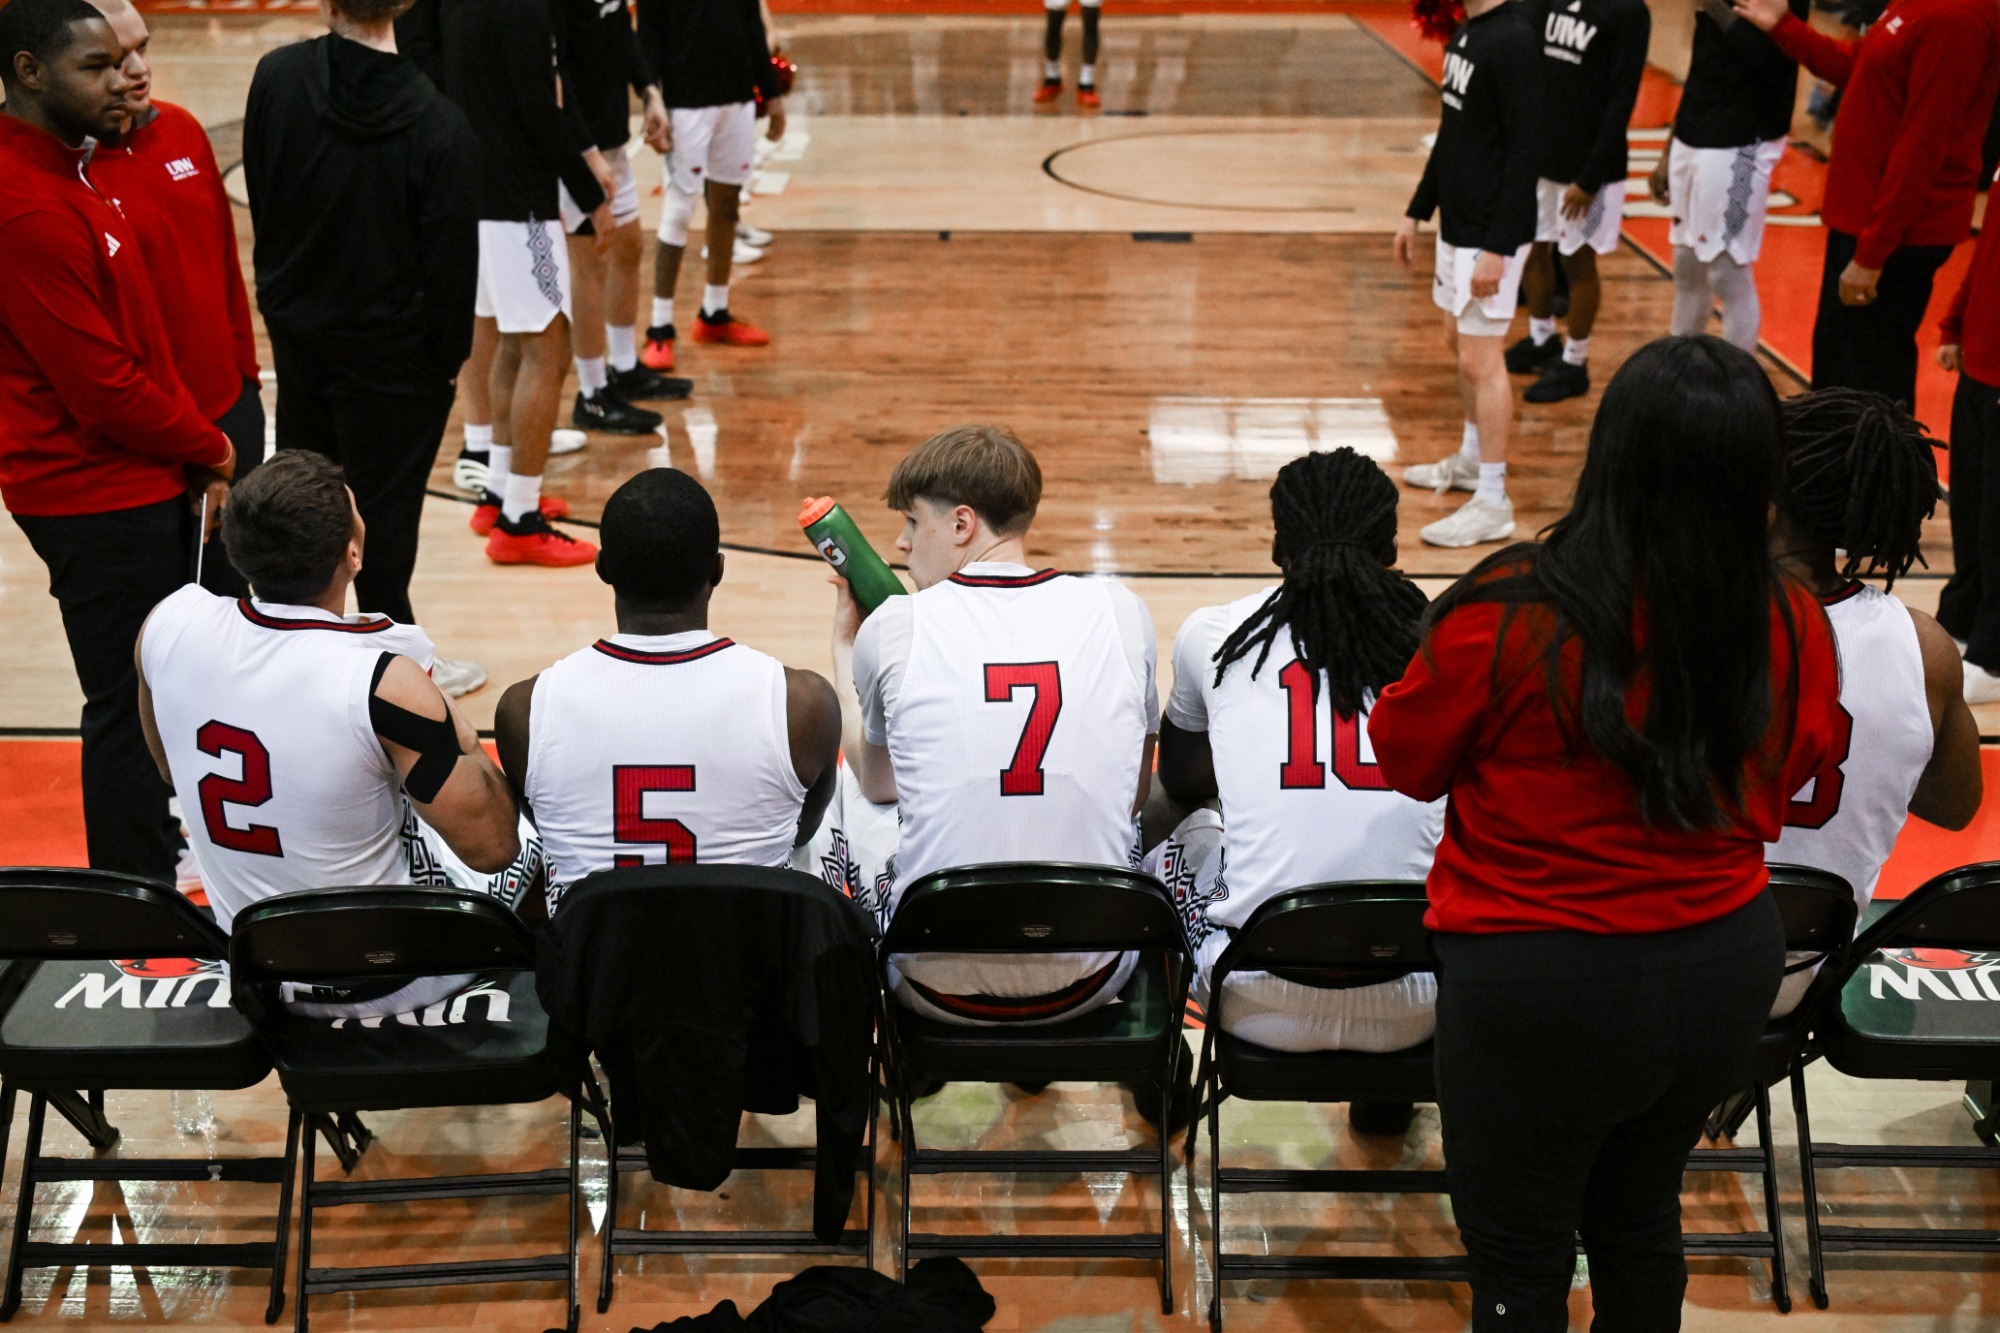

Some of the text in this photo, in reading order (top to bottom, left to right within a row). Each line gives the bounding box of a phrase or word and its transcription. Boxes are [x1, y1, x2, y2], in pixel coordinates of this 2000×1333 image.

[1544, 11, 1598, 51] UIW
[164, 156, 195, 176] UIW
[817, 536, 847, 567] G
[983, 660, 1063, 796] 7
[197, 719, 284, 858] 2
[612, 764, 697, 868] 5
